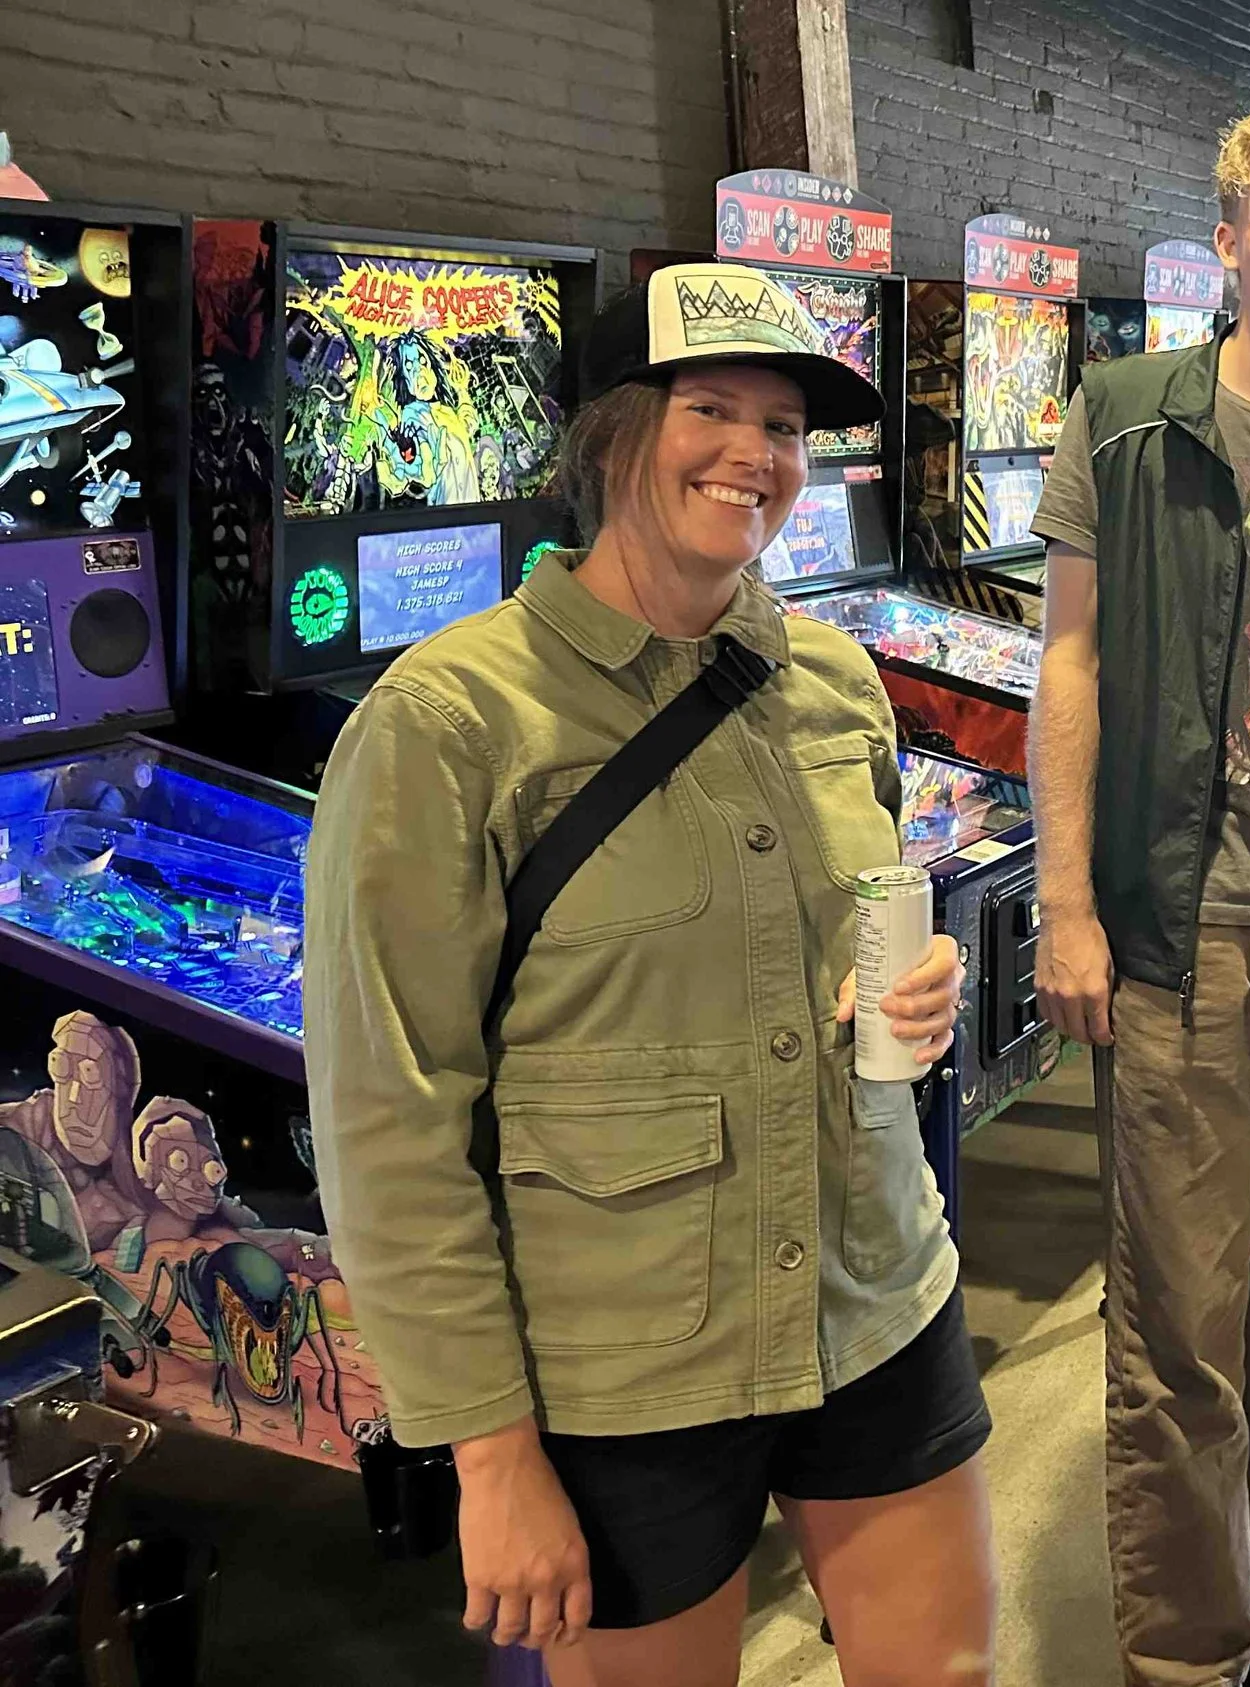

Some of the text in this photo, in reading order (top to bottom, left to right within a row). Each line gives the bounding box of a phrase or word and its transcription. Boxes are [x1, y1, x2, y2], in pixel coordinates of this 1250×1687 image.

[746, 209, 891, 252] SCAN PLAY SHARE
[1010, 251, 1027, 273] PLAY
[1052, 257, 1078, 280] SHARE
[348, 273, 513, 314] ALICE COOPER'S
[345, 301, 448, 329] NIGHTMARE
[396, 543, 422, 557] HIGH
[395, 564, 421, 578] HIGH
[422, 560, 454, 575] SCORE
[410, 575, 450, 591] JAMESP
[0, 622, 34, 655] T:
